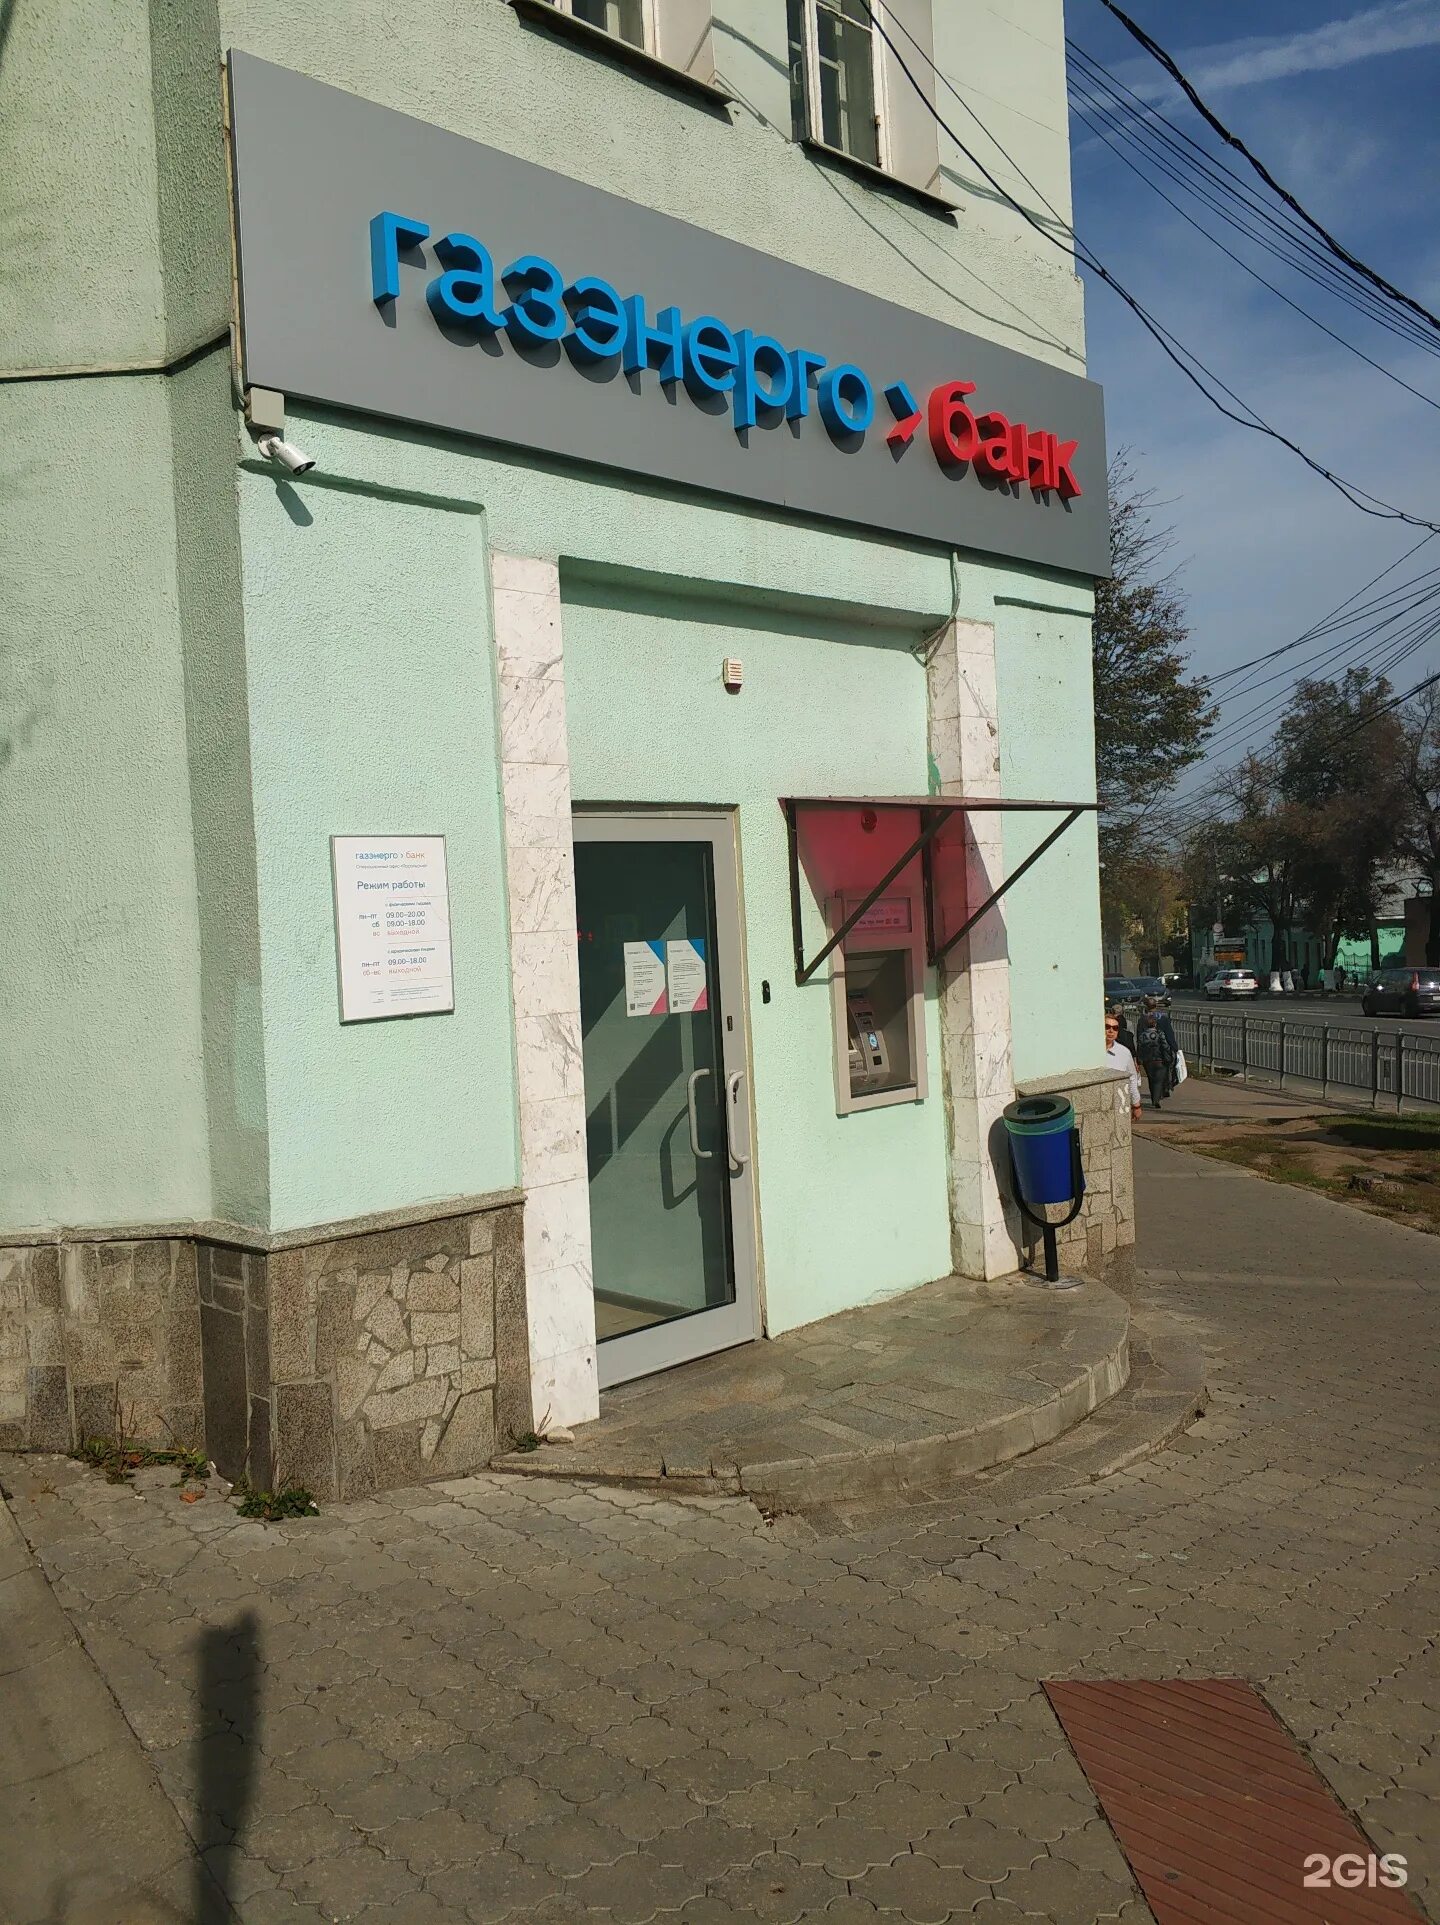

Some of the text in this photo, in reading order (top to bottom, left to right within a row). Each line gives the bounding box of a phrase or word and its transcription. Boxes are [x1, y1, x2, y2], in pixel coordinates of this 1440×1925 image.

[370, 211, 1082, 499] газэнерго банк
[355, 850, 425, 861] газэнерго банк
[357, 880, 425, 890] Режим работы
